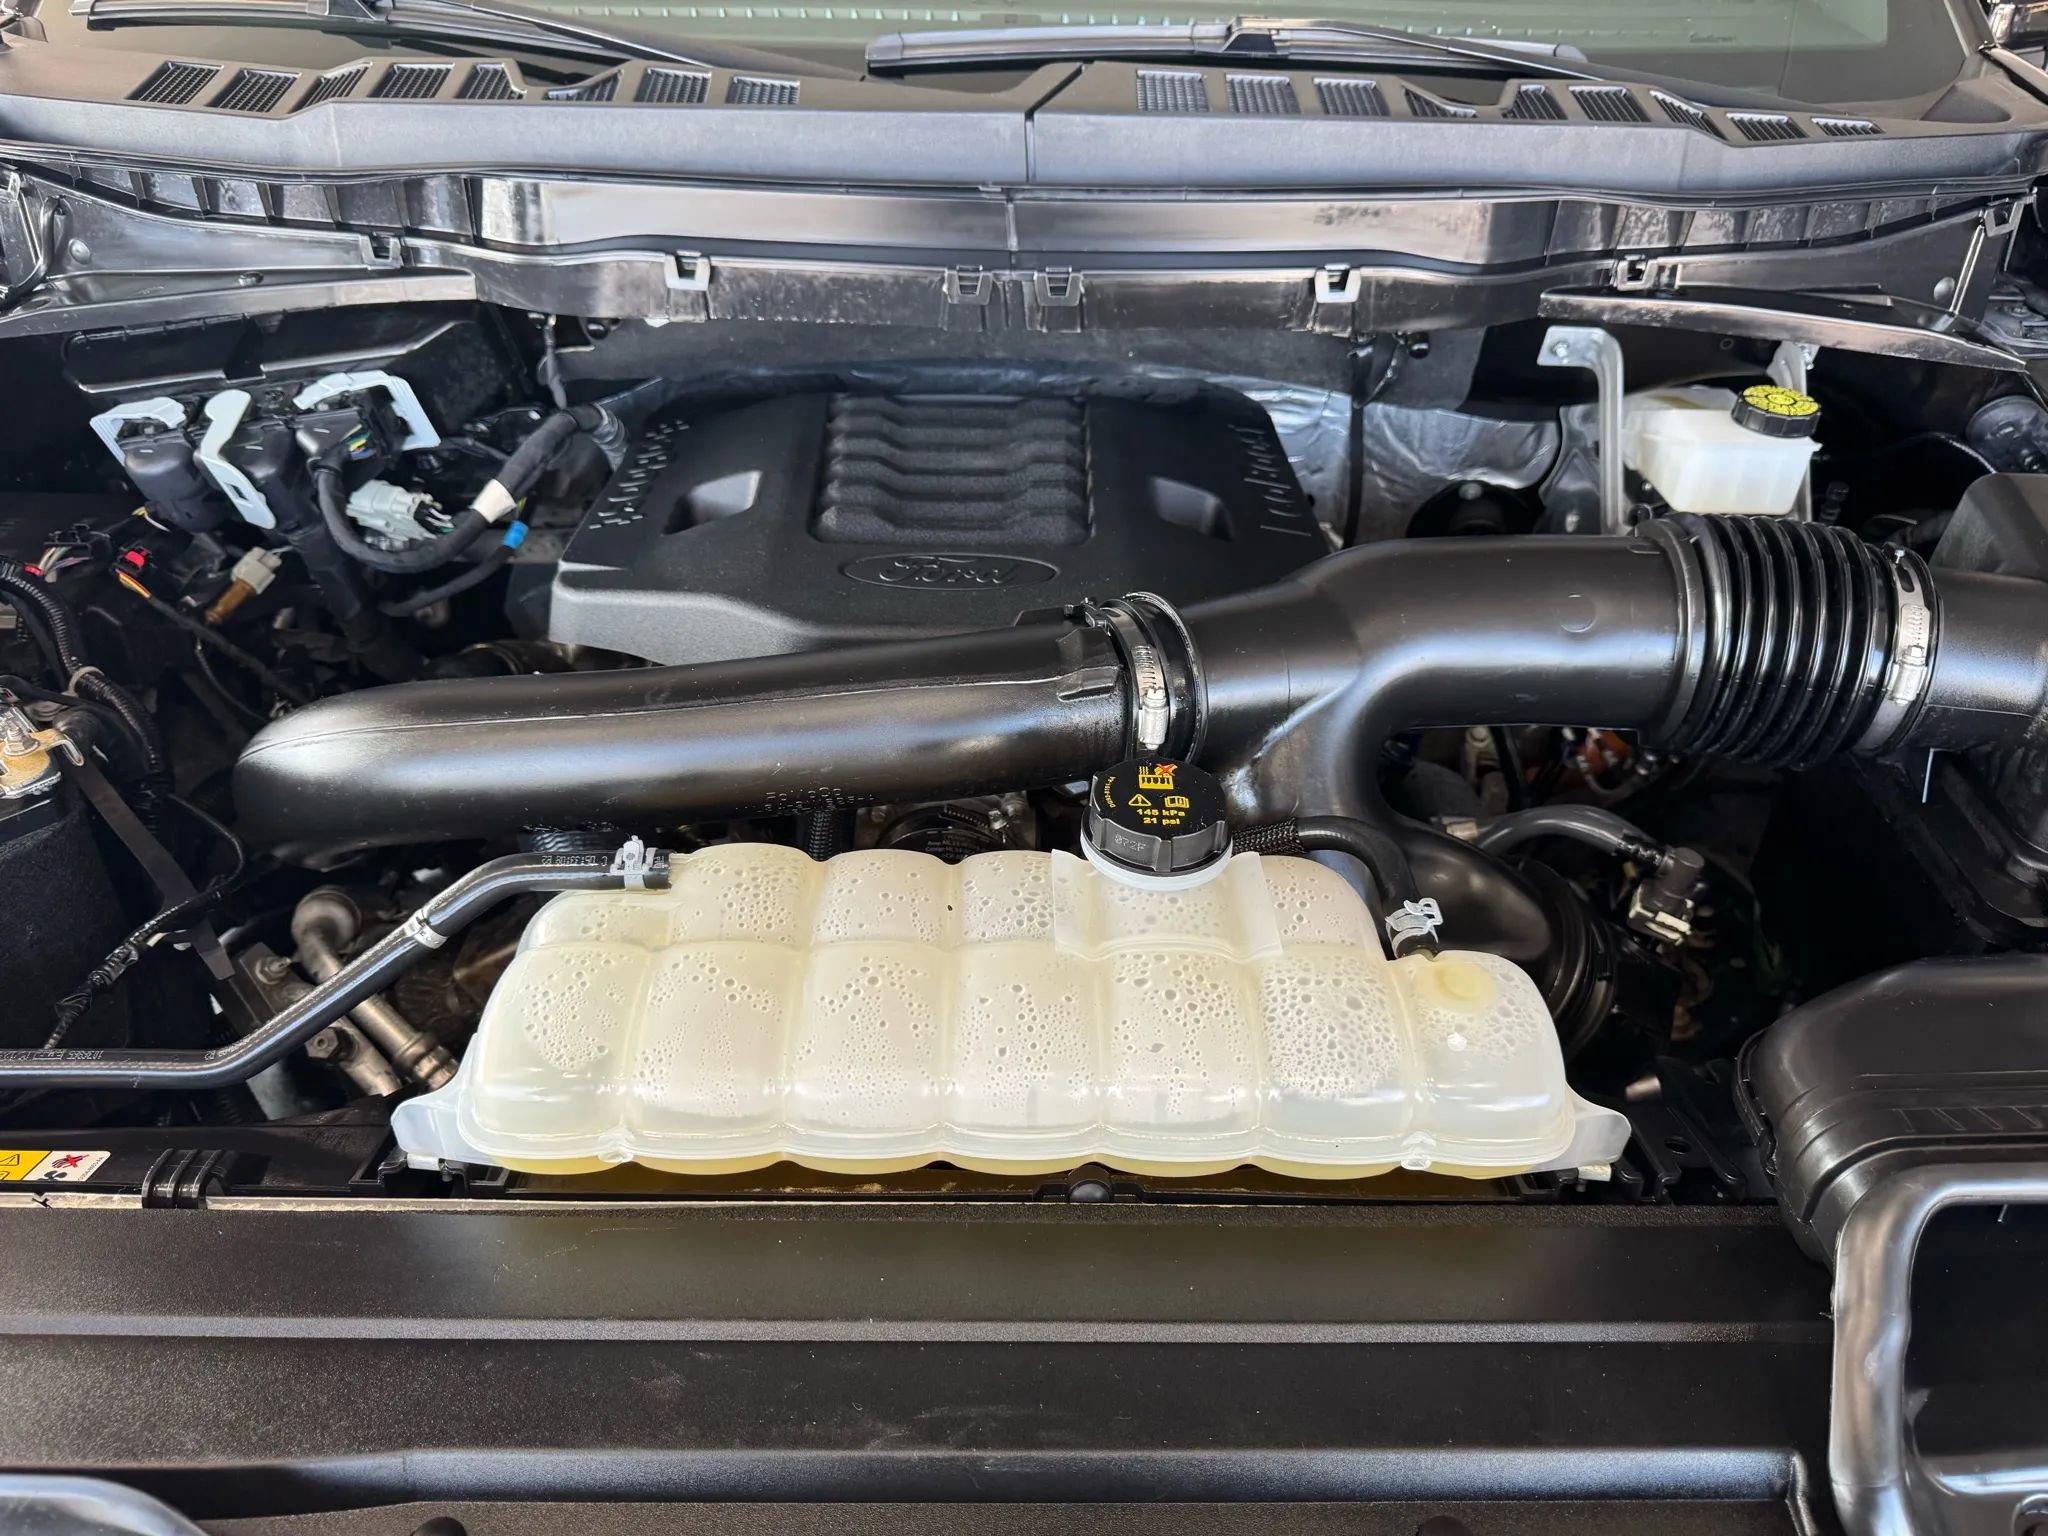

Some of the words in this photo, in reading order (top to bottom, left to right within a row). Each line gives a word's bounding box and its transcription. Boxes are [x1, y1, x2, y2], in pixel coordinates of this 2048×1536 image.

[878, 555, 1018, 584] Ford
[1136, 808, 1159, 816] 145
[1162, 809, 1186, 817] kPa
[1162, 818, 1180, 826] psi
